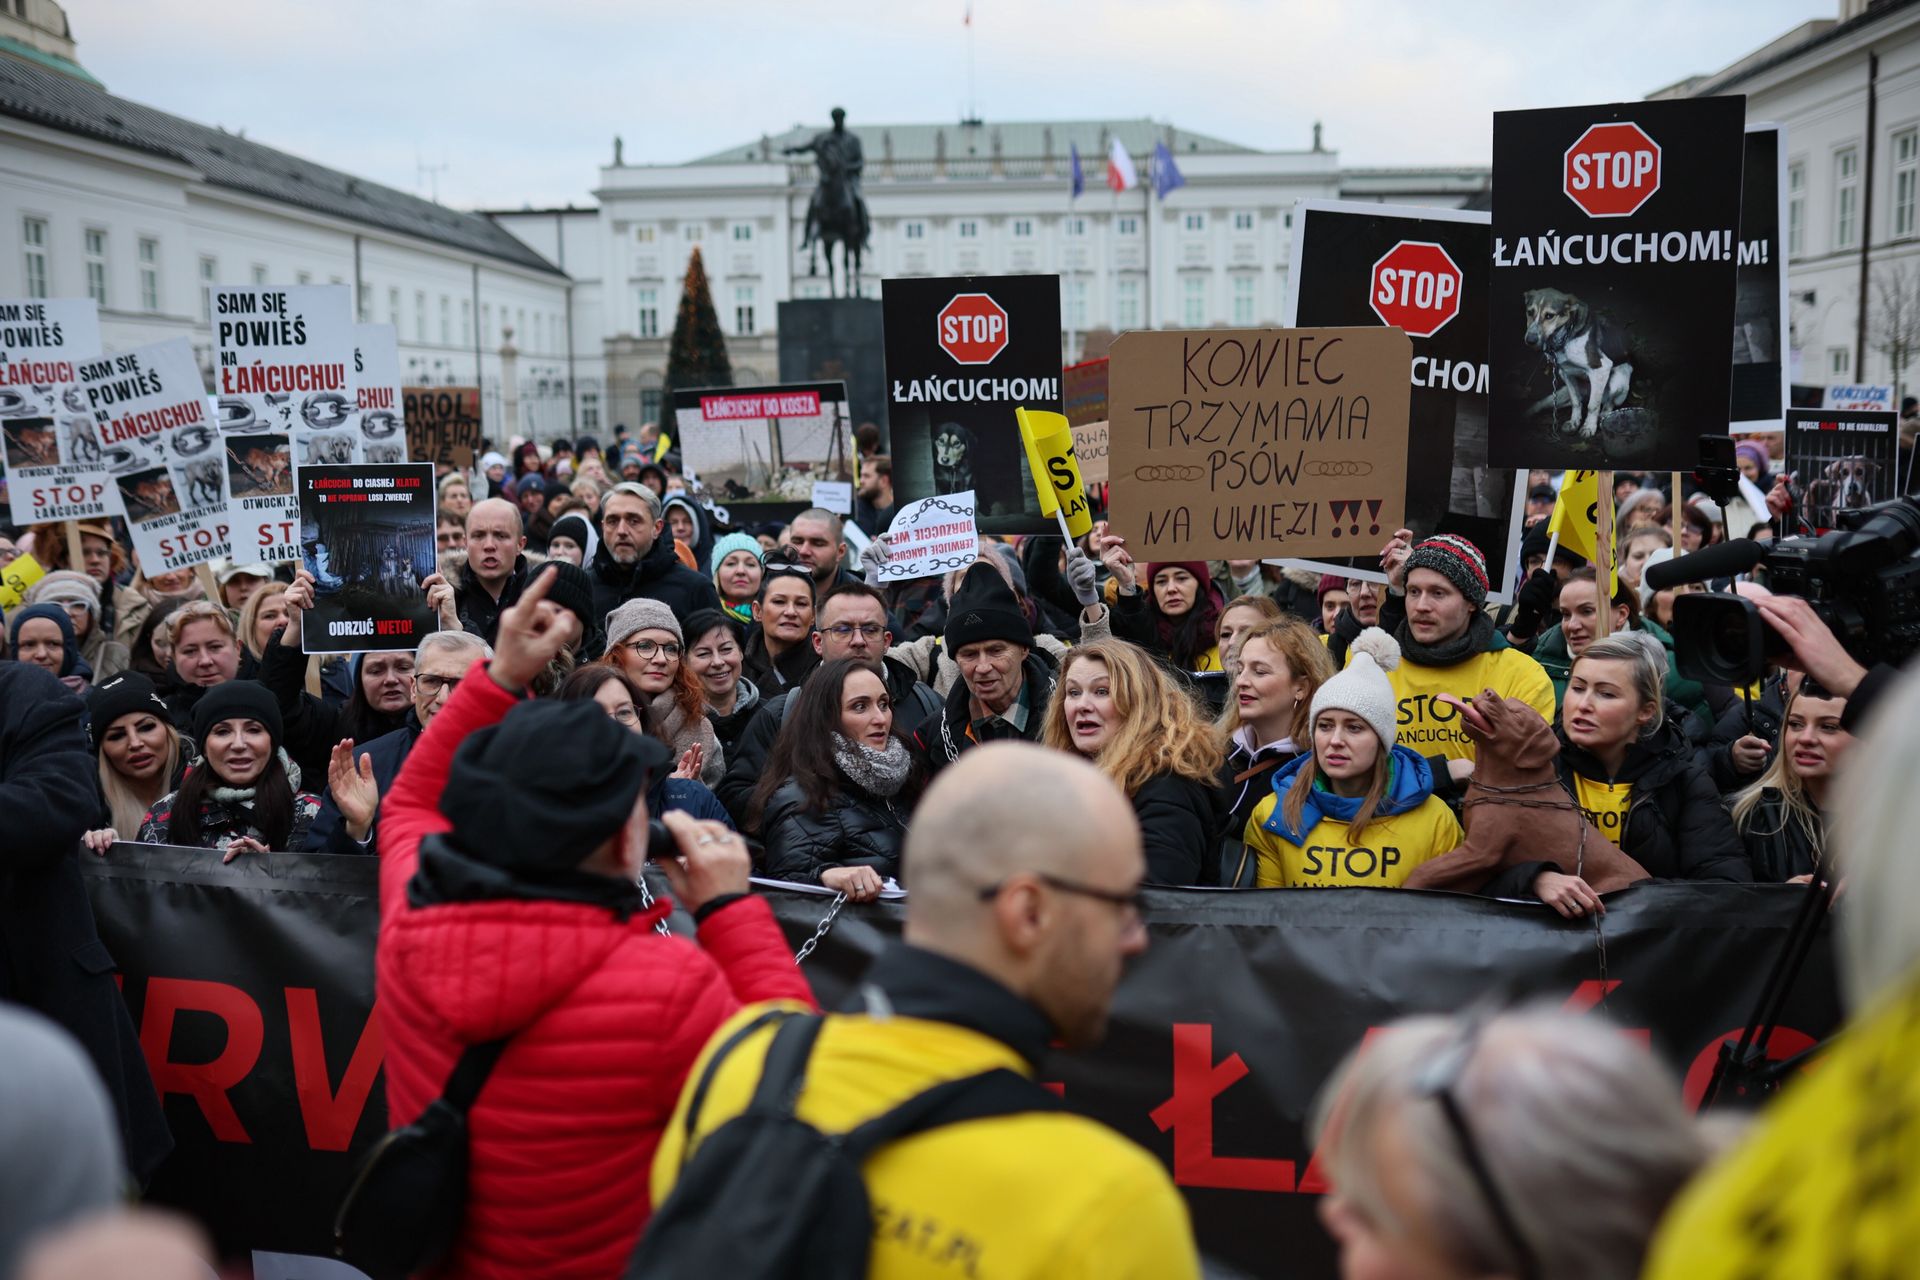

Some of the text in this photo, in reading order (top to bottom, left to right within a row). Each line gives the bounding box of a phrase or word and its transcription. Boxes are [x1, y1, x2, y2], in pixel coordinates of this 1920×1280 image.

[1572, 150, 1653, 190] STOP
[1493, 230, 1731, 266] ŁAŃCUCHOM!
[1378, 267, 1454, 310] STOP
[25, 304, 46, 326] SIĘ
[217, 293, 287, 319] SAM SIĘ
[0, 322, 63, 347] OWIEŚ
[219, 314, 307, 347] POWIEŚ
[944, 315, 1003, 343] STOP
[79, 354, 139, 382] SAM SIĘ
[221, 352, 237, 366] NA
[1183, 337, 1344, 394] KONIEC
[87, 369, 162, 408] POWIEŚ
[222, 360, 346, 394] ŁAŃCUCHU!
[893, 375, 1058, 402] ŁAŃCUCHOM!
[95, 410, 110, 422] NA
[404, 391, 477, 420] AROL!
[705, 396, 817, 418] ŁAŃCUCHY DO KOSZA
[99, 400, 205, 445] ŁAŃCUCHU!
[1134, 396, 1370, 449] TRZYMANIA
[1076, 429, 1107, 446] RWA
[1207, 442, 1304, 491] PSÓW
[33, 484, 103, 507] STOP
[309, 480, 313, 489] Z
[353, 479, 362, 488] DO
[365, 478, 395, 488] CIASNEJ
[35, 502, 104, 519] ŁAŃCUCHOM
[243, 496, 286, 510] OTWOCKI
[319, 494, 326, 503] TO
[368, 494, 383, 502] LOSU
[384, 493, 413, 504] ZWIERZĄT
[142, 514, 177, 532] OTWOCKI
[258, 522, 293, 546] ST
[1144, 507, 1190, 545] NA
[1328, 499, 1383, 538] !!!
[160, 525, 229, 557] STOP
[164, 543, 232, 568] ŁAŃCUCHOM
[328, 617, 413, 636] ODRZUĆ WETO!
[1396, 726, 1472, 744] AŃCUCHO
[1590, 810, 1628, 830] TOP
[1302, 846, 1401, 878] STOP
